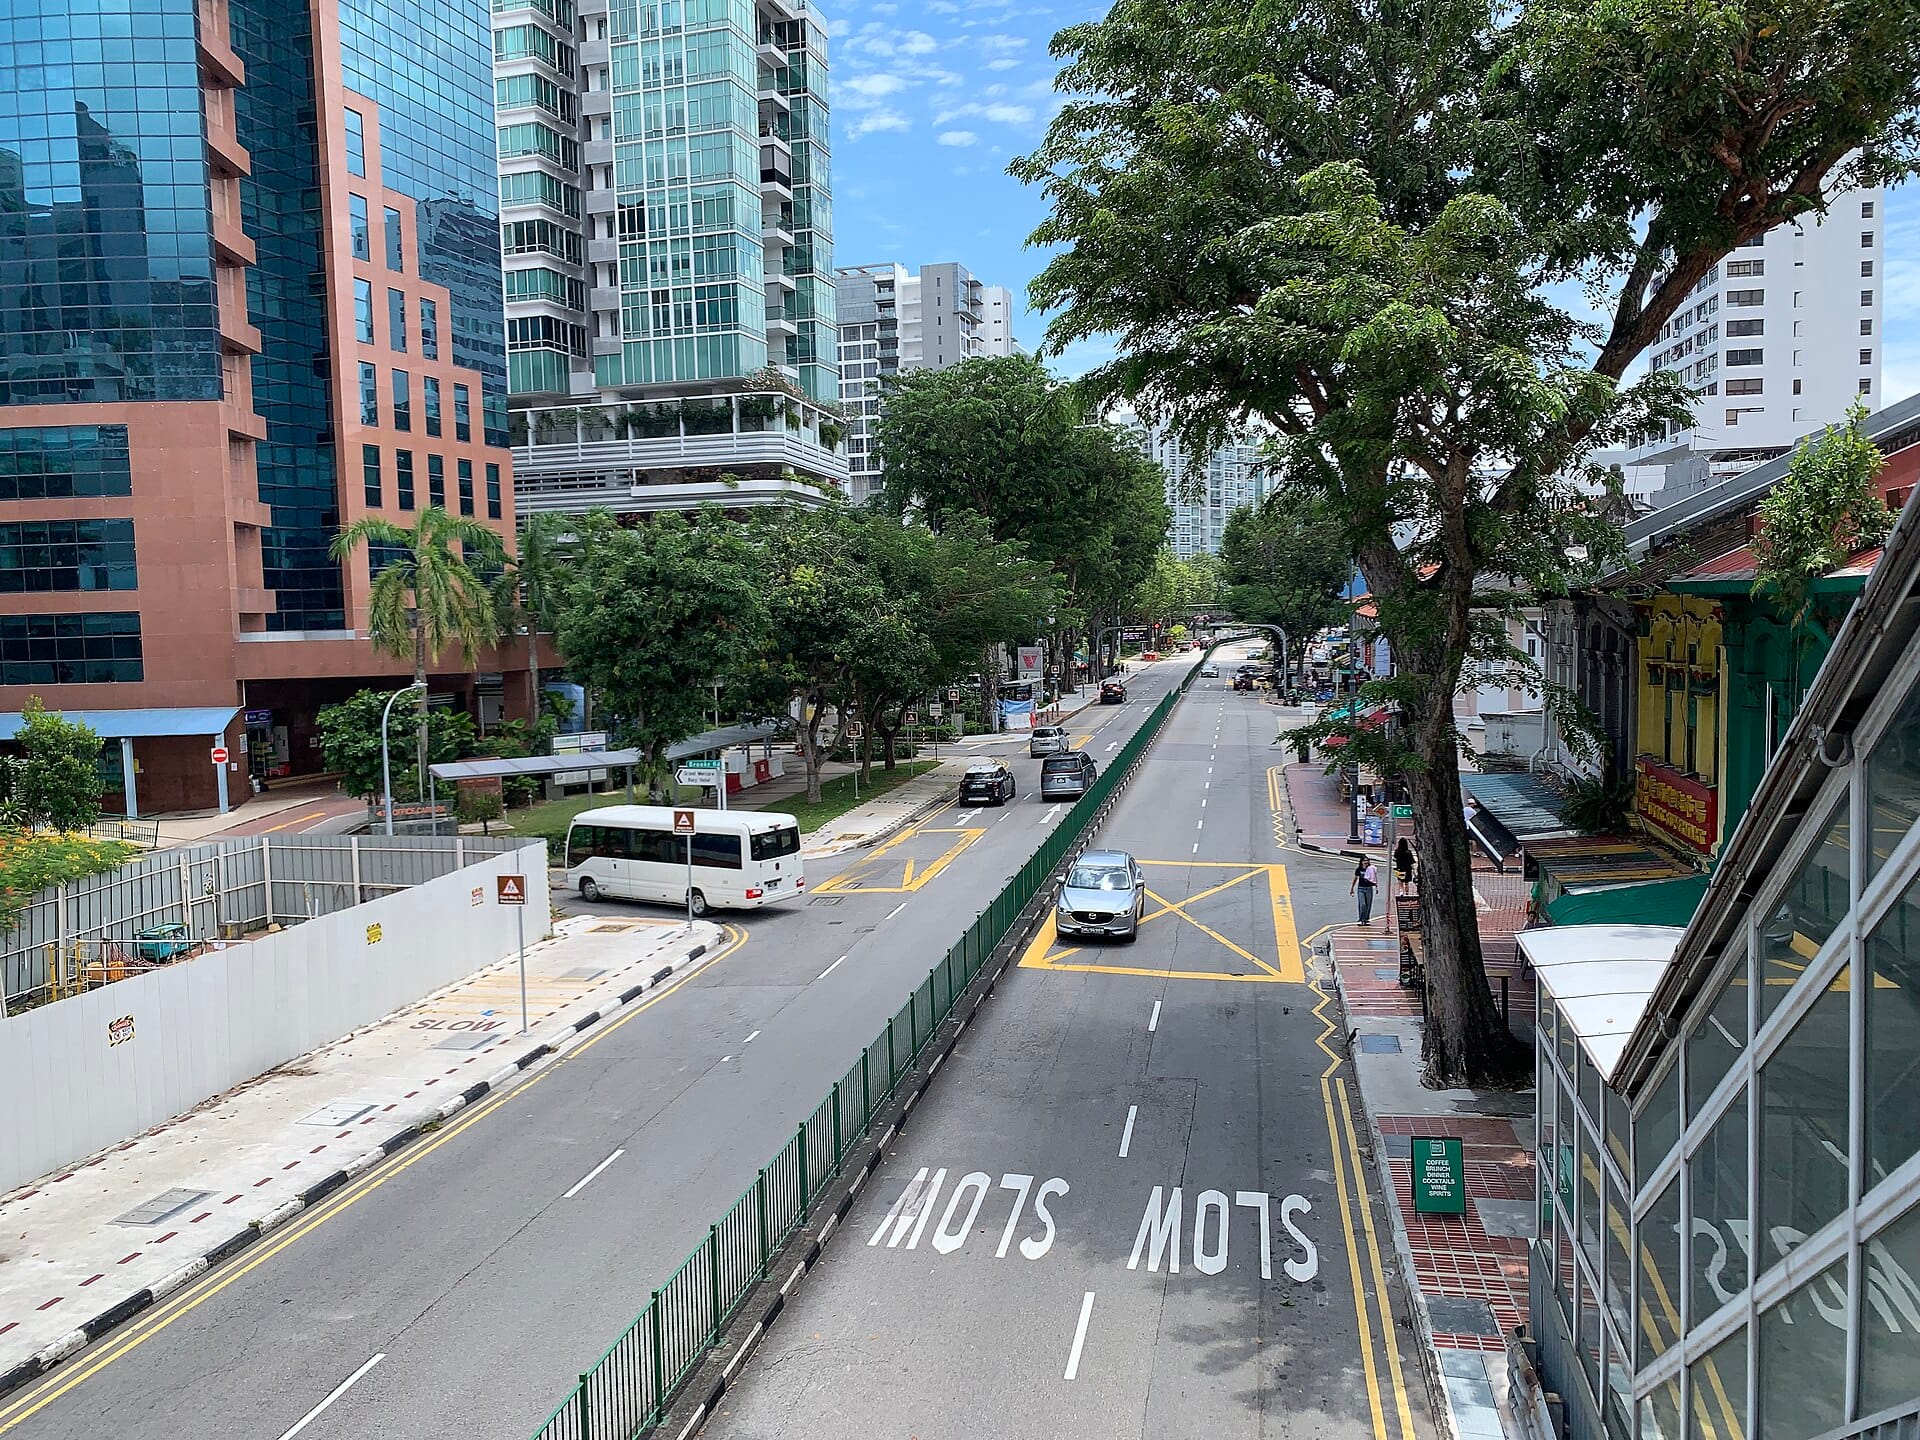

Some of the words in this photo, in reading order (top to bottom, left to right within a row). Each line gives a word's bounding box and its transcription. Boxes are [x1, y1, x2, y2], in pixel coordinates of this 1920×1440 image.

[409, 1018, 507, 1032] SLOW
[866, 1166, 1071, 1261] SLOW
[1126, 1185, 1318, 1283] SLOW
